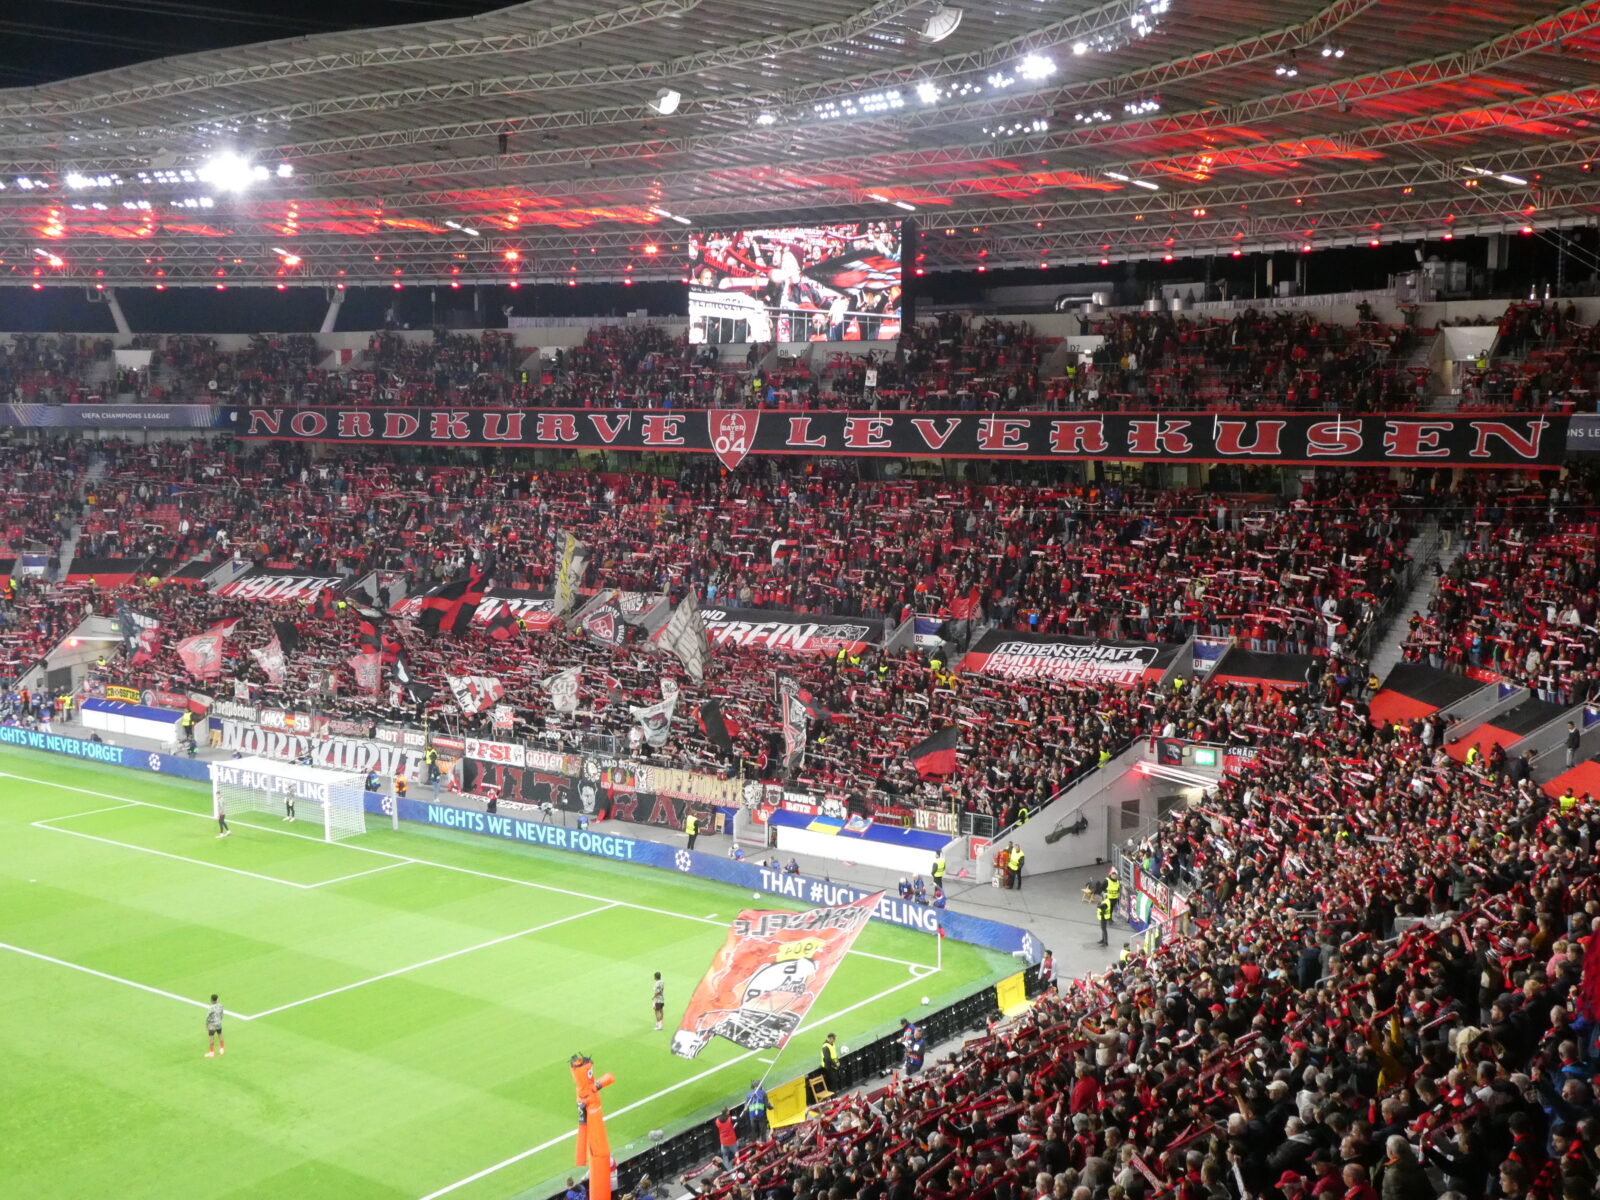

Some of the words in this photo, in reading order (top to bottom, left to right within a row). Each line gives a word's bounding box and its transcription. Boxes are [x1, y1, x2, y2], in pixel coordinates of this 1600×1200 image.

[101, 412, 142, 420] CHAMPIONS
[144, 412, 170, 420] LEAGUE
[249, 408, 686, 445] NORDKURVE
[715, 436, 747, 454] 04
[785, 416, 1549, 459] LEVERKUSEN
[915, 635, 924, 643] D2
[991, 653, 1102, 669] EMOTIONEN
[1000, 643, 1143, 660] LEIDENSCHAFT
[1194, 659, 1203, 667] D1
[28, 731, 45, 748] WE
[47, 735, 80, 755] NEVER
[82, 742, 124, 763] FORGET
[477, 740, 512, 760] FSI
[207, 764, 240, 784] THAT
[275, 777, 327, 801] FELING
[784, 791, 817, 805] YOUNG
[916, 809, 930, 829] LEV
[429, 804, 484, 831] NIGHTS
[488, 814, 513, 837] WE
[516, 821, 567, 847] NEVER
[570, 832, 635, 859] FORGET
[760, 869, 806, 898] THAT
[859, 893, 938, 931] EELING
